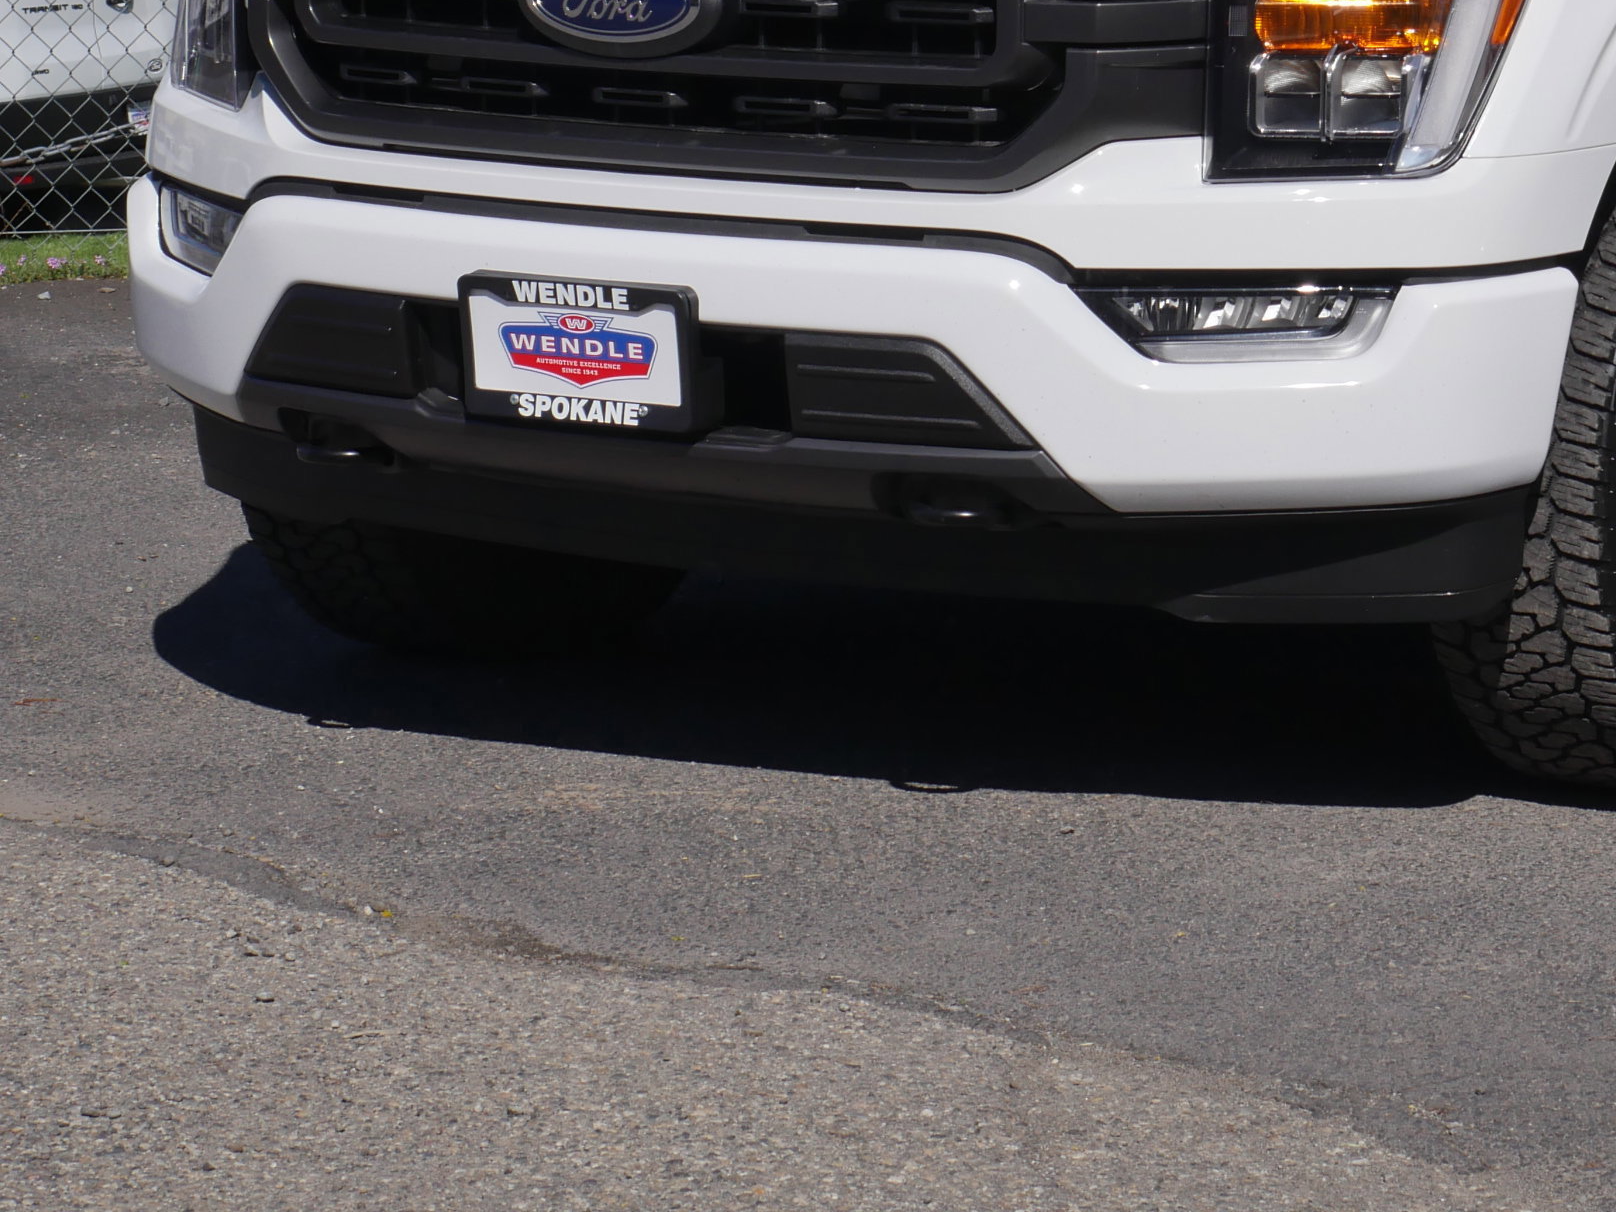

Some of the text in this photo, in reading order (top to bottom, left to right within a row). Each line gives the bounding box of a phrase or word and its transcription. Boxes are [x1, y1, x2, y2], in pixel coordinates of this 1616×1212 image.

[512, 280, 630, 311] WENDLE
[510, 333, 645, 360] WENDLE
[536, 357, 622, 370] AUTOMOTIVE EXCELLENCE
[561, 367, 581, 375] SINCE
[518, 393, 641, 426] SPOKANE
